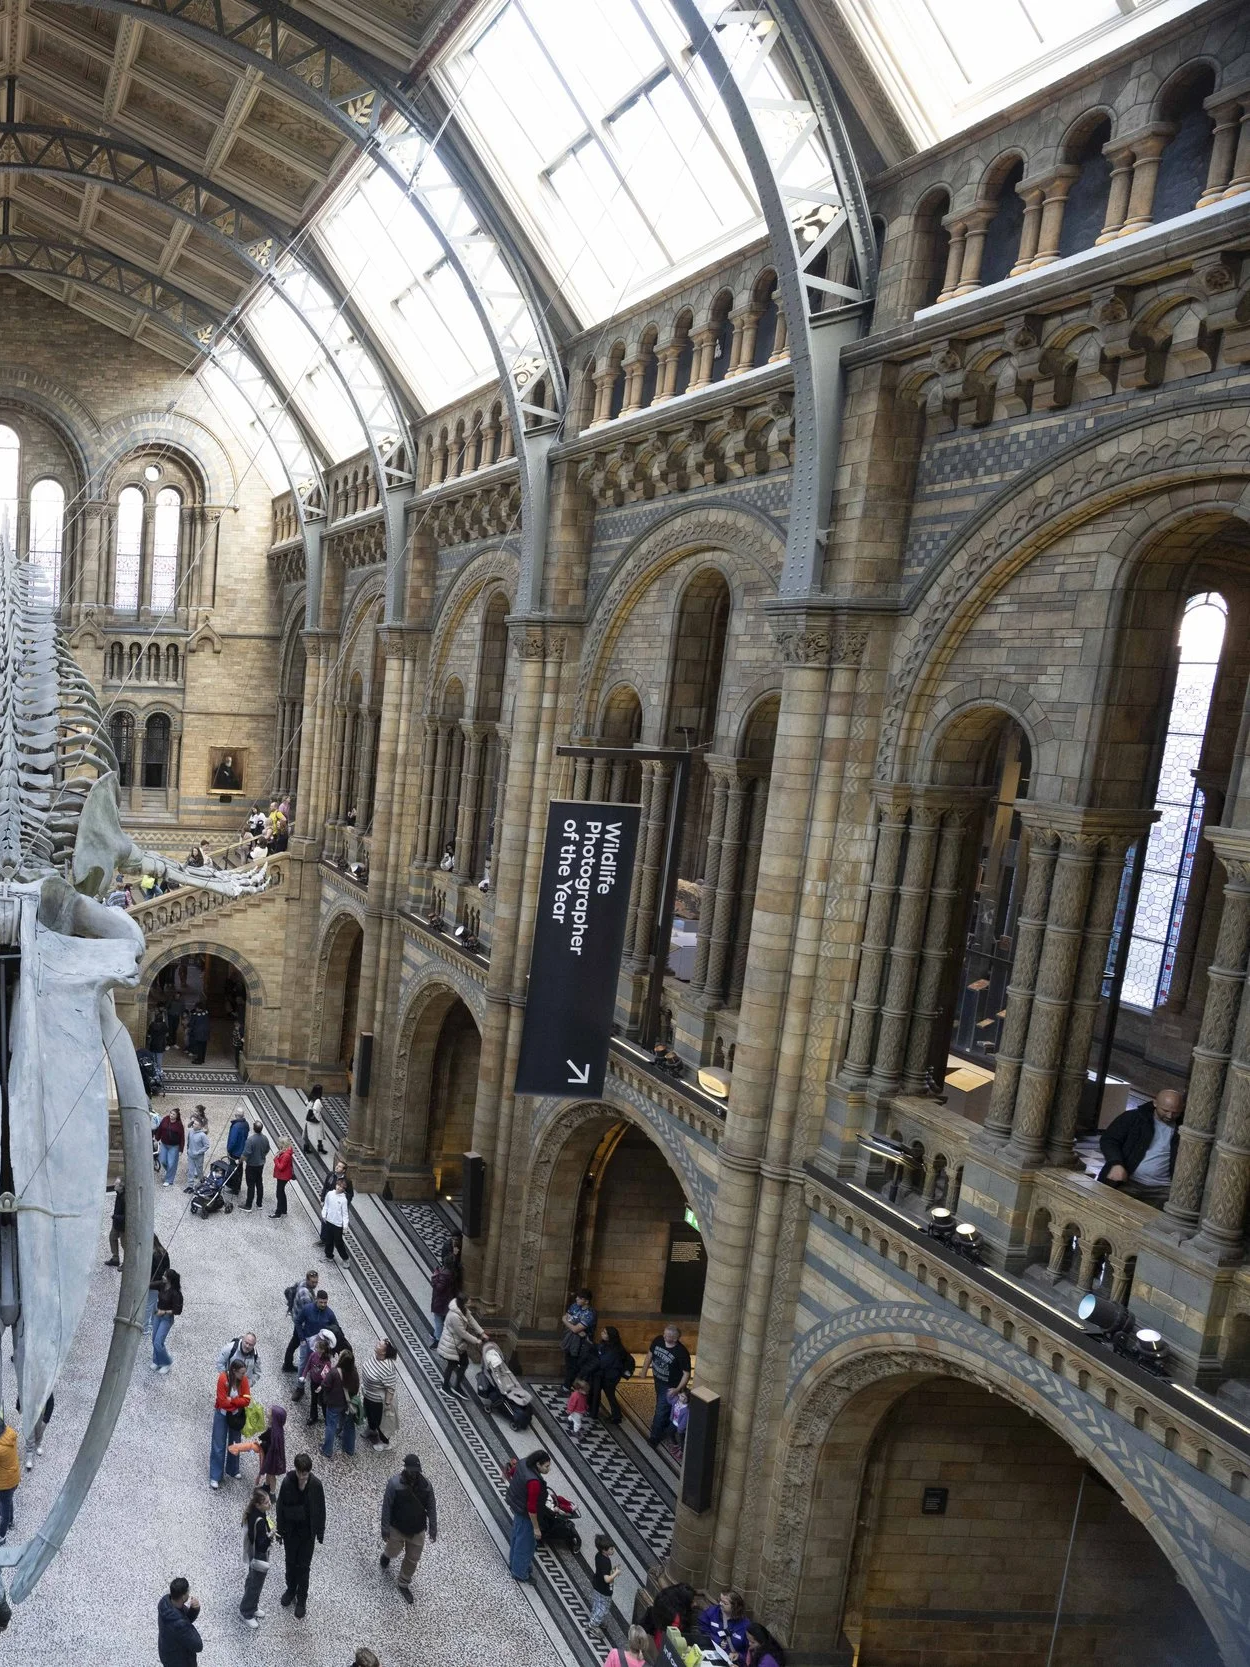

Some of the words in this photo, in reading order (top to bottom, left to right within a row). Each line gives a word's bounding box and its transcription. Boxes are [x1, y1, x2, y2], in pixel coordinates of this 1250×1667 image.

[563, 819, 580, 843] of
[558, 844, 577, 877] the
[597, 822, 623, 895] Wildlife
[552, 879, 574, 924] Year
[570, 821, 603, 956] Photographer
